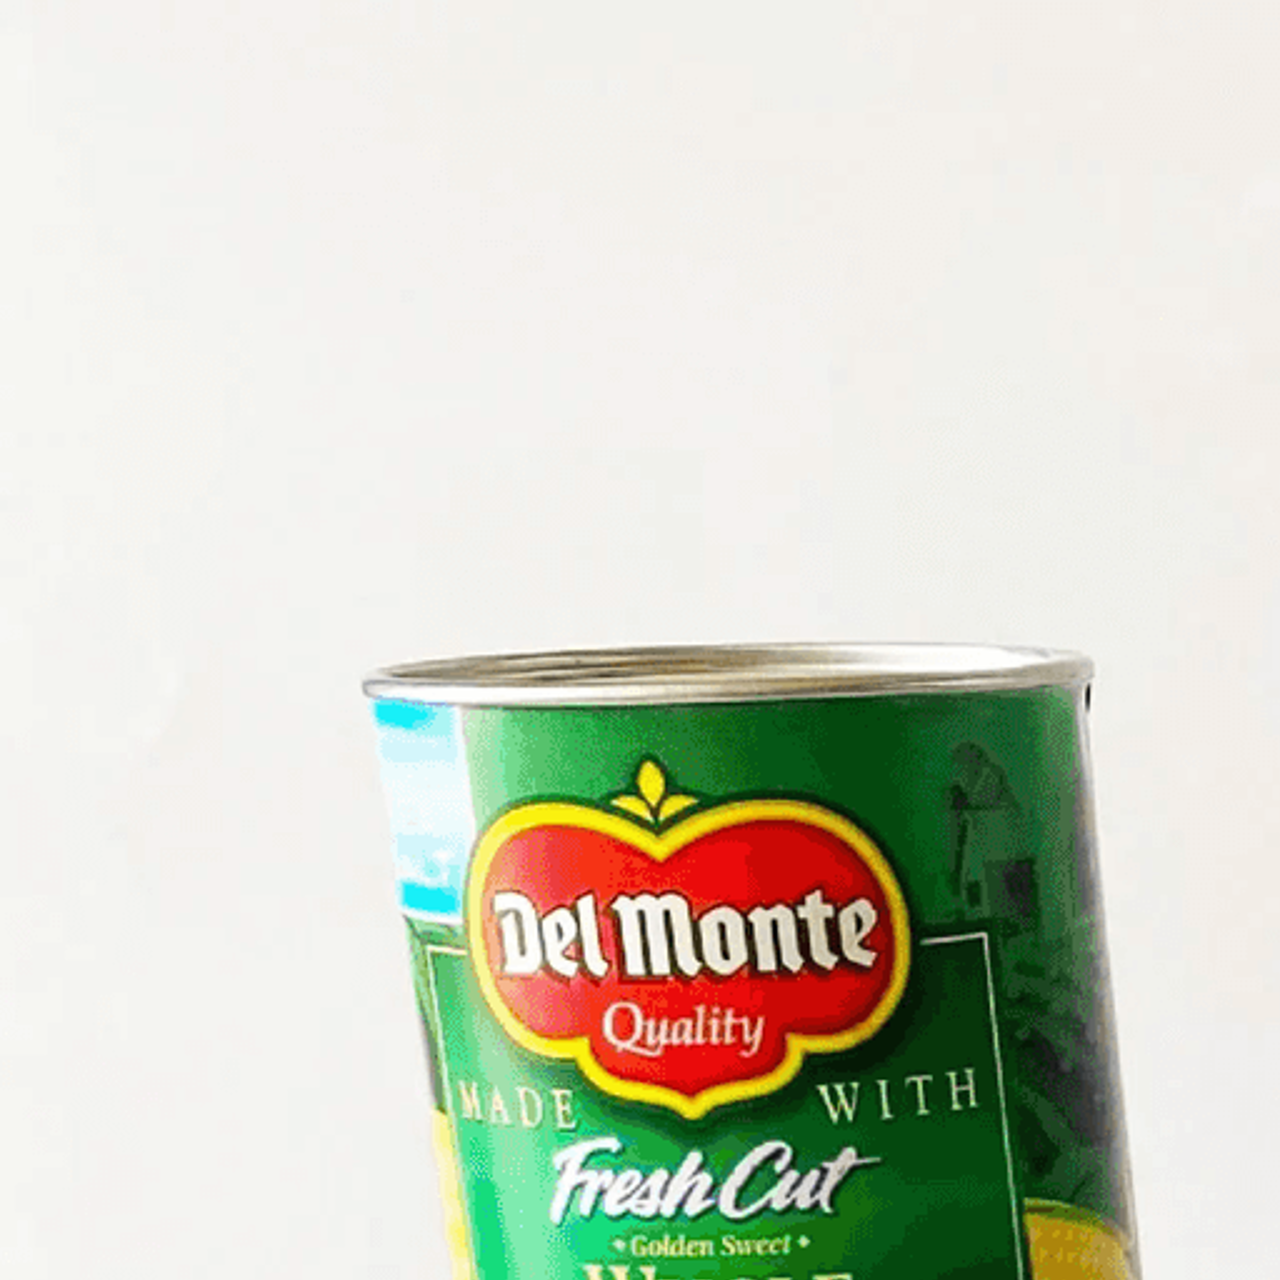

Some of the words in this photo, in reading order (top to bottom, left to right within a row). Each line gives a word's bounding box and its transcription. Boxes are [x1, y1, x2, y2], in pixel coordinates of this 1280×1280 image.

[494, 890, 609, 977] Del
[611, 889, 878, 978] Monte
[603, 1001, 765, 1057] Quality
[459, 1081, 580, 1130] MADE
[817, 1069, 978, 1124] WITH
[549, 1137, 715, 1226] Fresh
[718, 1141, 881, 1219] Cut
[631, 1234, 714, 1258] Golden
[721, 1234, 790, 1255] Sweet
